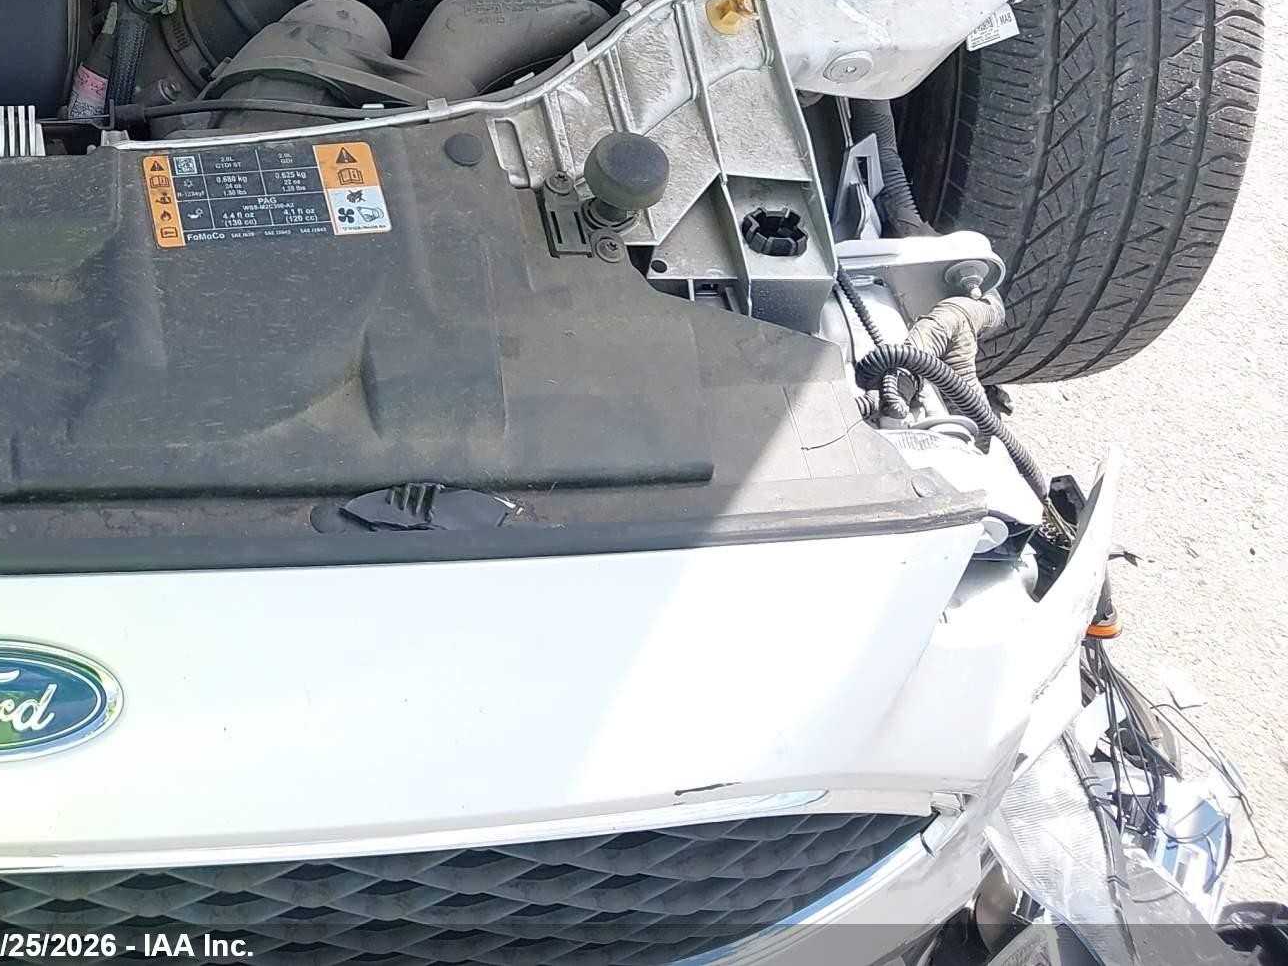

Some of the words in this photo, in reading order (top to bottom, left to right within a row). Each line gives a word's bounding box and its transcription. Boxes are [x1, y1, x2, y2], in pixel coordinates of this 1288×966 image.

[237, 175, 248, 183] kg
[296, 171, 307, 179] kg
[257, 196, 278, 205] PAG
[285, 215, 303, 223] (120
[305, 214, 318, 222] cc)
[224, 219, 242, 227] (130
[187, 231, 226, 242] FoMoCo
